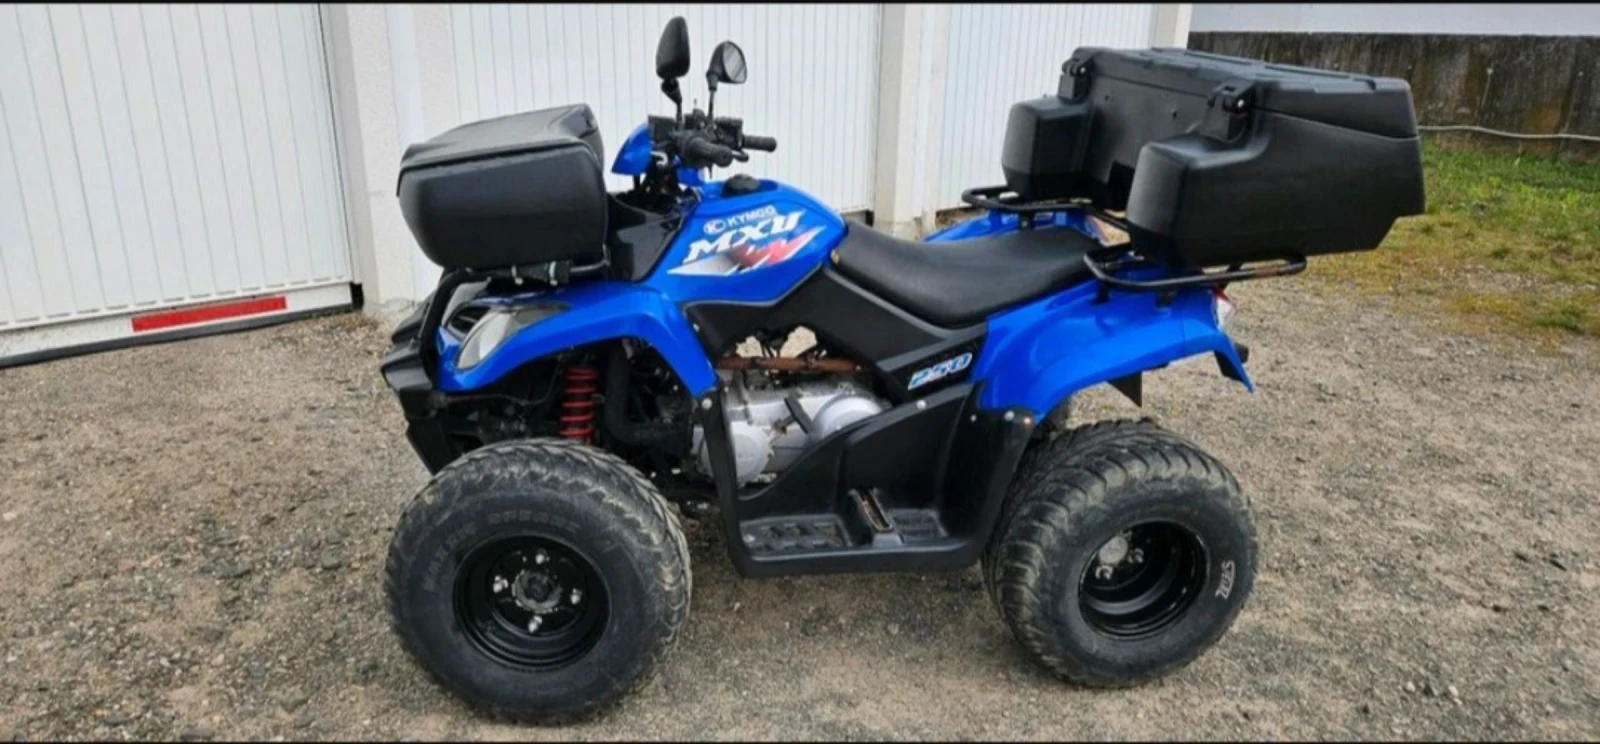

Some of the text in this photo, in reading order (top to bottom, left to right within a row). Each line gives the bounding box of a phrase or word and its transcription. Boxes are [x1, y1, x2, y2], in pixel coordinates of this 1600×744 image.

[727, 204, 778, 227] KYMCO
[676, 209, 807, 264] MXU
[907, 352, 973, 391] 250
